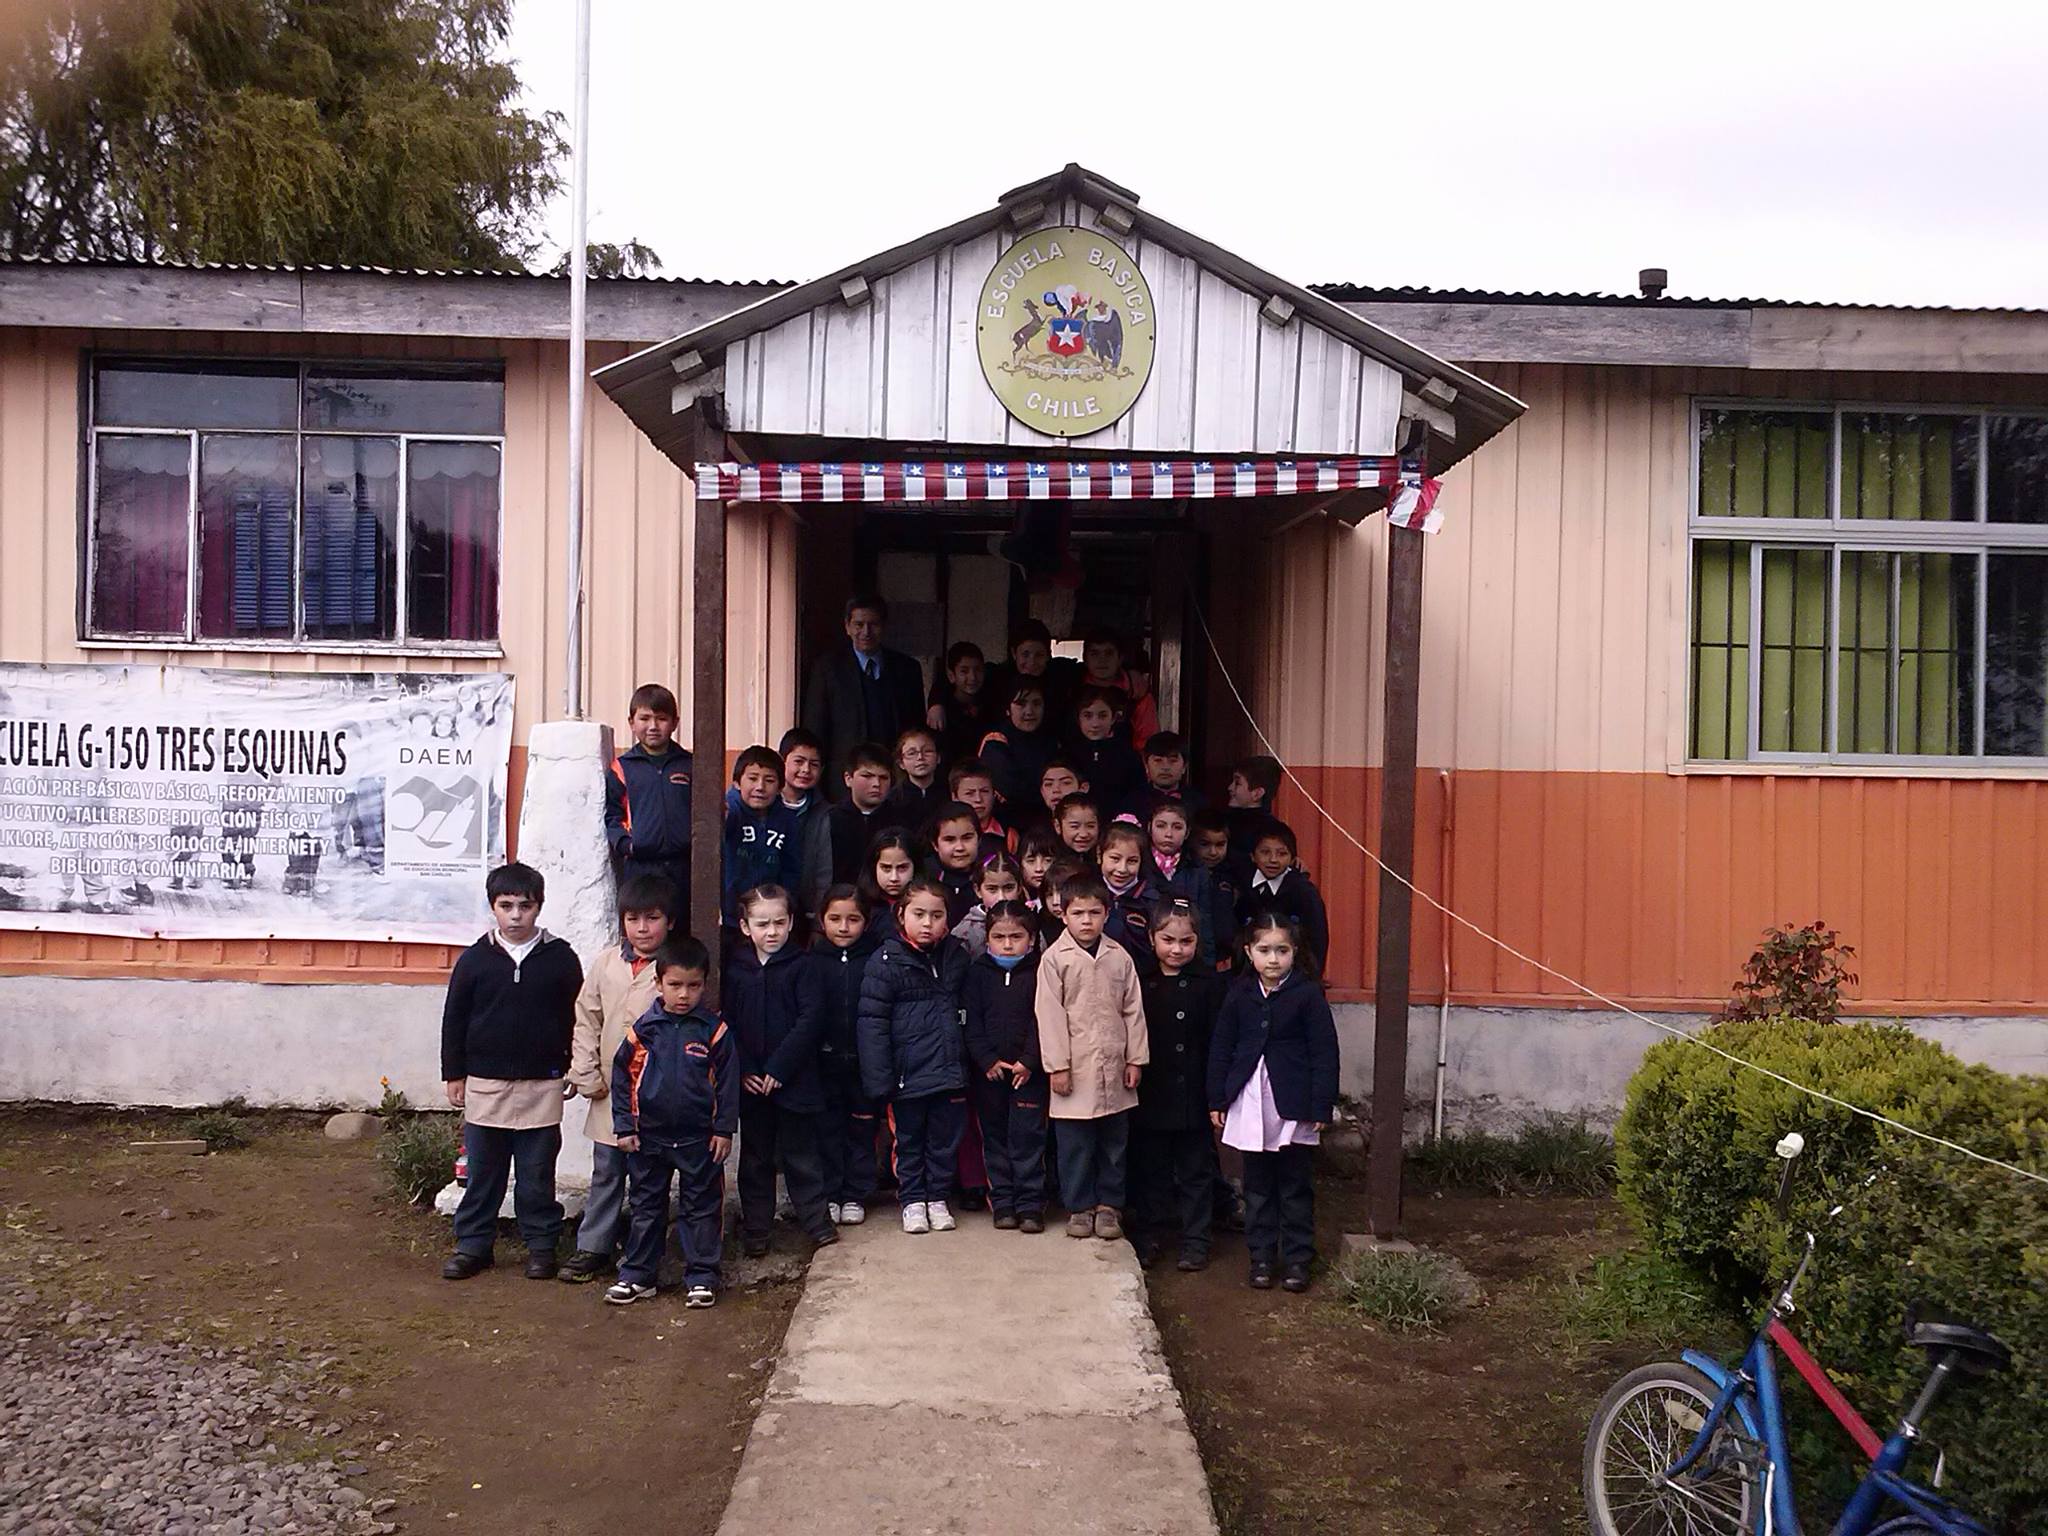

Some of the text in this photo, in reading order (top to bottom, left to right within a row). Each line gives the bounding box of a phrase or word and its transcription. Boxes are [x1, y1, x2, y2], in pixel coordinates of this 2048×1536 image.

[987, 242, 1147, 328] ESCUELA BASICA
[1026, 392, 1101, 418] CHILE
[78, 723, 149, 770] G-150
[156, 725, 215, 772] TRES
[223, 727, 347, 779] ESQUINAS
[399, 747, 473, 766] DAEM
[52, 778, 143, 800] PRE-BÁSICA
[144, 783, 155, 799] Y
[157, 779, 215, 803] BÁSICA,
[218, 784, 347, 805] REFORZAMIENTO
[75, 806, 145, 826] TALLERES
[148, 809, 169, 826] DE
[171, 806, 257, 828] EDUCACIÓN
[261, 808, 311, 829] FÍSICA
[311, 814, 322, 829] Y
[61, 831, 137, 850] ATENCIÓN
[243, 837, 318, 855] INTERNET
[318, 840, 330, 856] Y
[51, 856, 252, 879] BIBLIOTECA COMUNITARIA.
